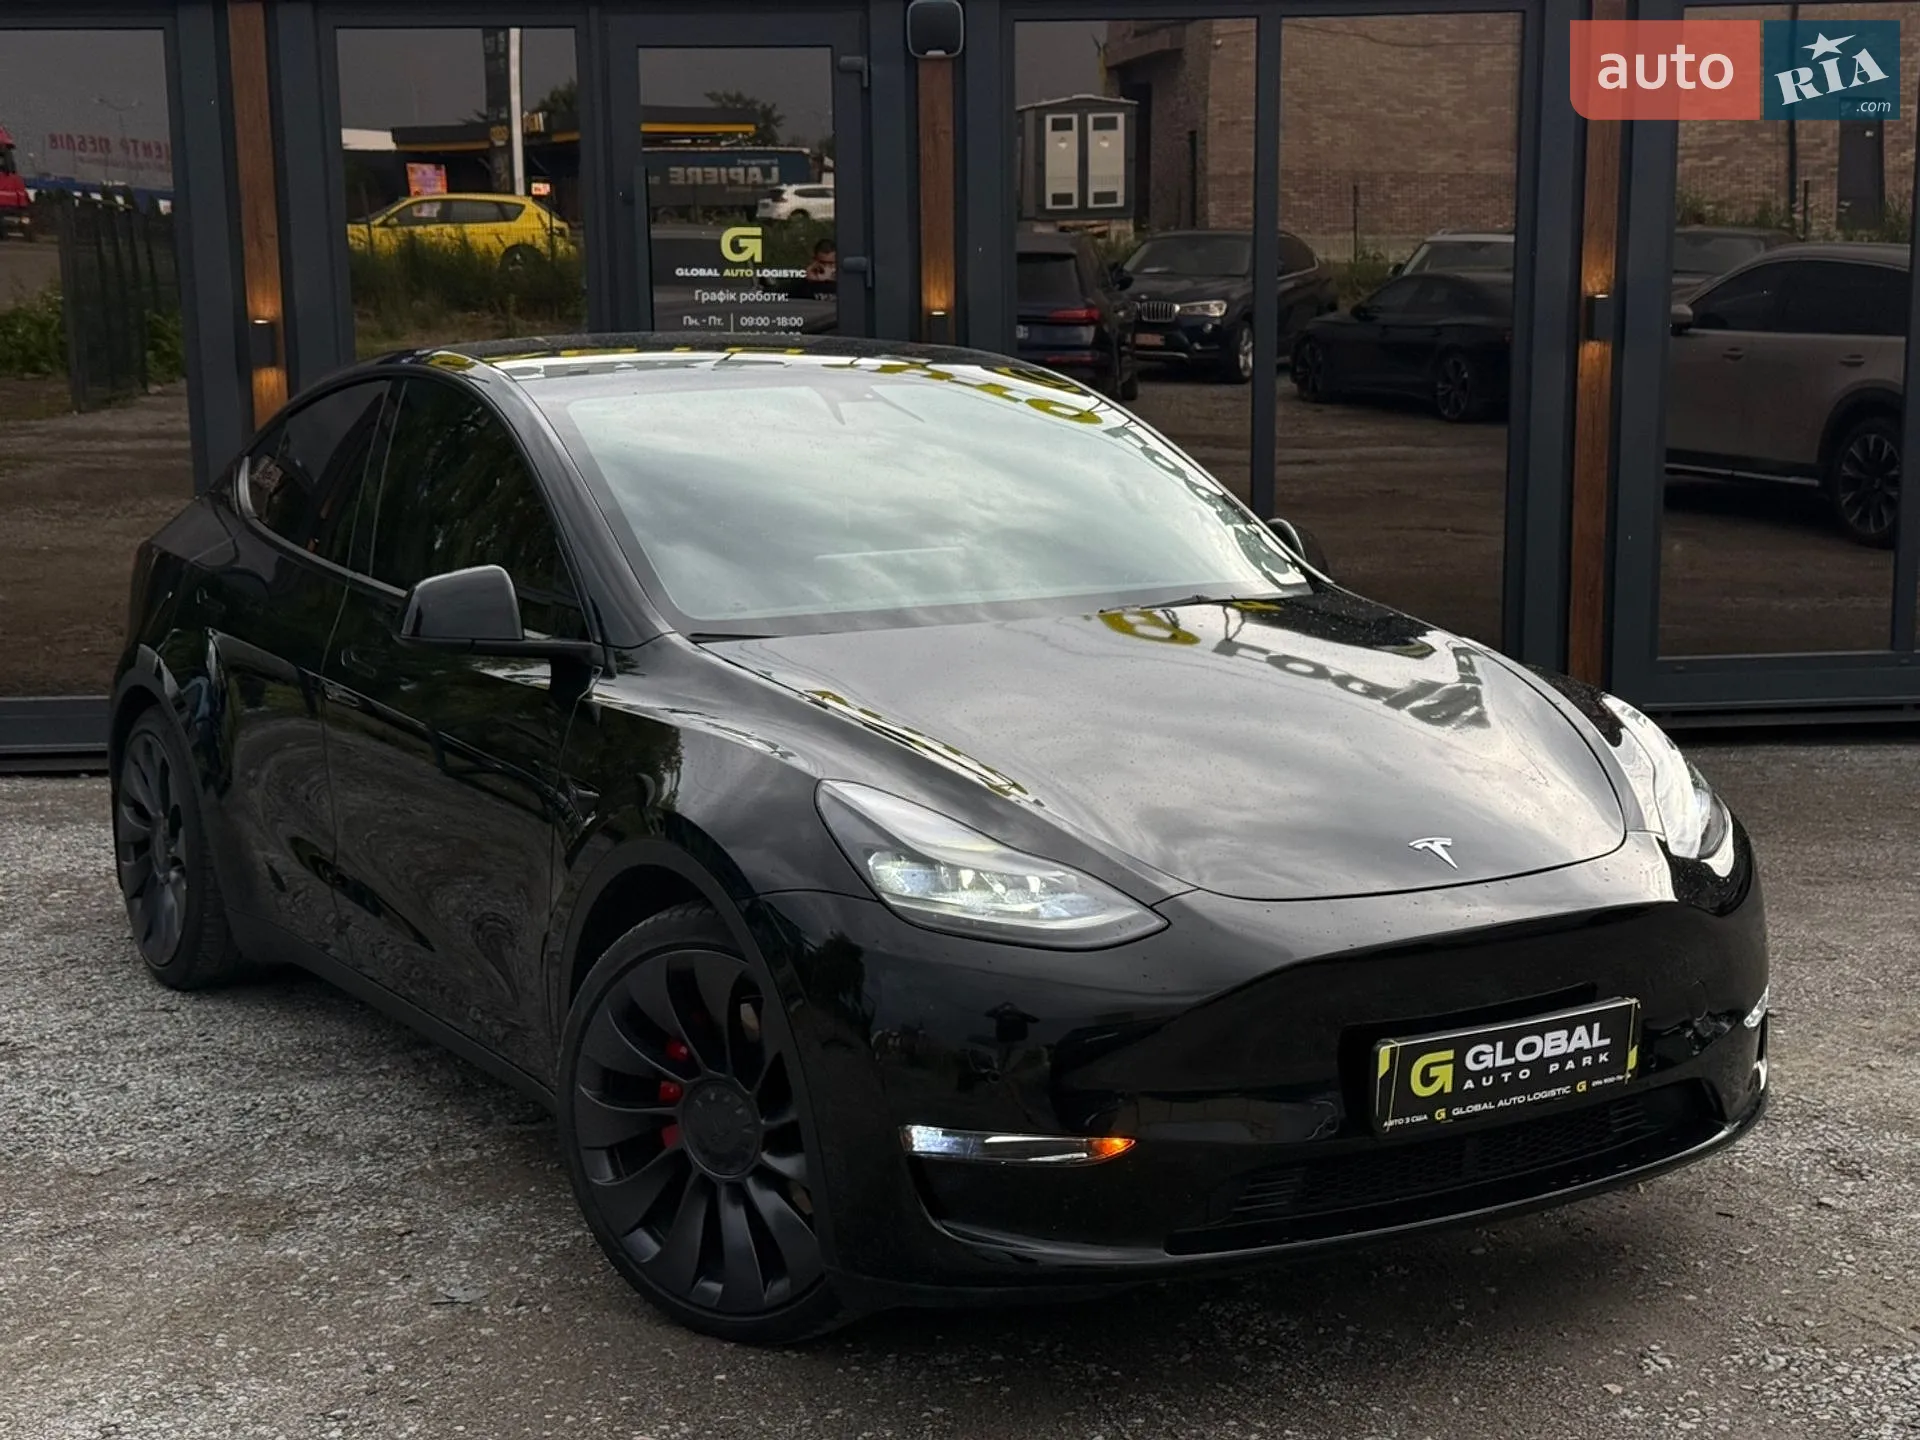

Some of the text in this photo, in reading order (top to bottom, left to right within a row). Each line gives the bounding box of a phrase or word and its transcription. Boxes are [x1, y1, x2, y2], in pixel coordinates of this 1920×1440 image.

[675, 267, 807, 278] GLOBAL AUTO LOGISTIC
[694, 289, 789, 304] Графік роботи:
[740, 316, 770, 327] 09:00
[1464, 1022, 1612, 1072] GLOBAL
[1463, 1051, 1611, 1091] AUTO PARK
[1452, 1100, 1495, 1117] GLOBAL
[1497, 1094, 1526, 1108] AUTO
[1527, 1085, 1571, 1103] LOGISTIC
